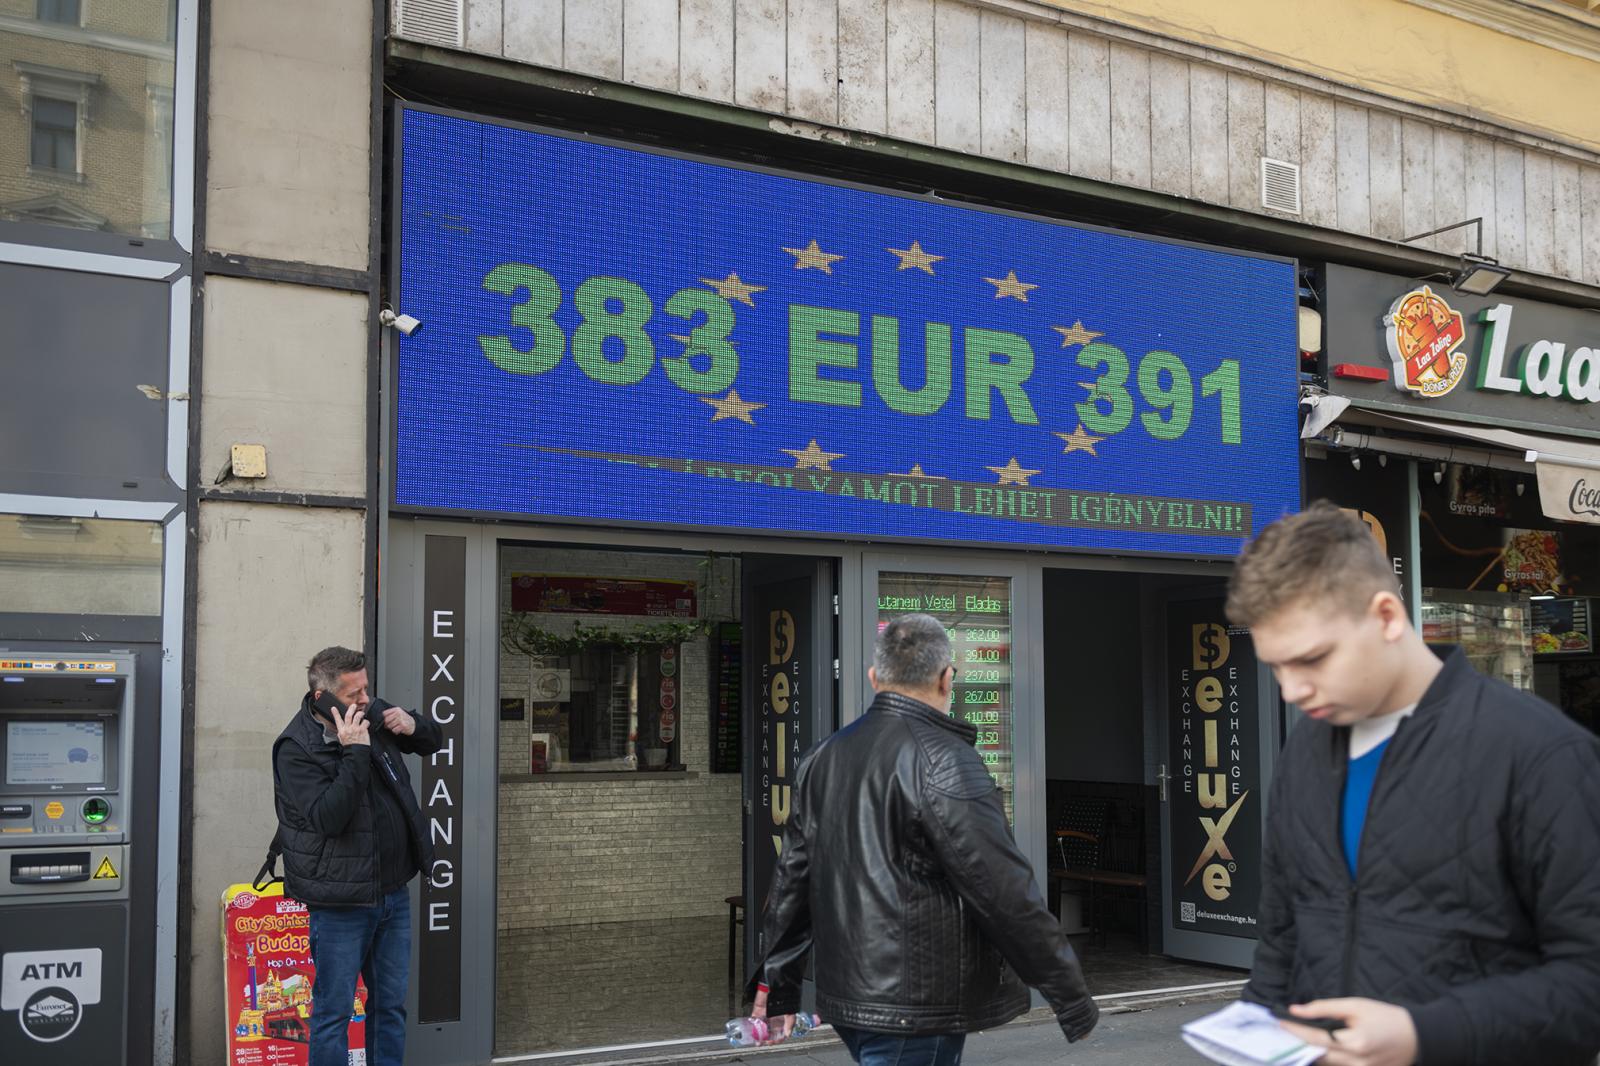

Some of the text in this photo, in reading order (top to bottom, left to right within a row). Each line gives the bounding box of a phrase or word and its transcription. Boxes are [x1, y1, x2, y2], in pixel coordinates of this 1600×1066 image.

[478, 262, 1242, 445] 383 EUR 391
[1415, 352, 1432, 370] Laa
[1477, 303, 1600, 403] Laa
[952, 485, 1056, 518] LEHET
[1069, 492, 1243, 531] IGÉNYELNI!
[1450, 500, 1496, 516] Gyros pita
[1504, 568, 1530, 581] Gyros
[1181, 669, 1193, 793] EXCHANGE
[1229, 667, 1241, 795] EXCHANGE
[429, 610, 455, 931] EXCHANGE
[235, 916, 262, 933] City
[1196, 910, 1257, 925] deluxeexchange.hu
[256, 932, 310, 953] Budap
[21, 961, 82, 980] ATM
[267, 959, 283, 967] Hop
[285, 957, 297, 965] On
